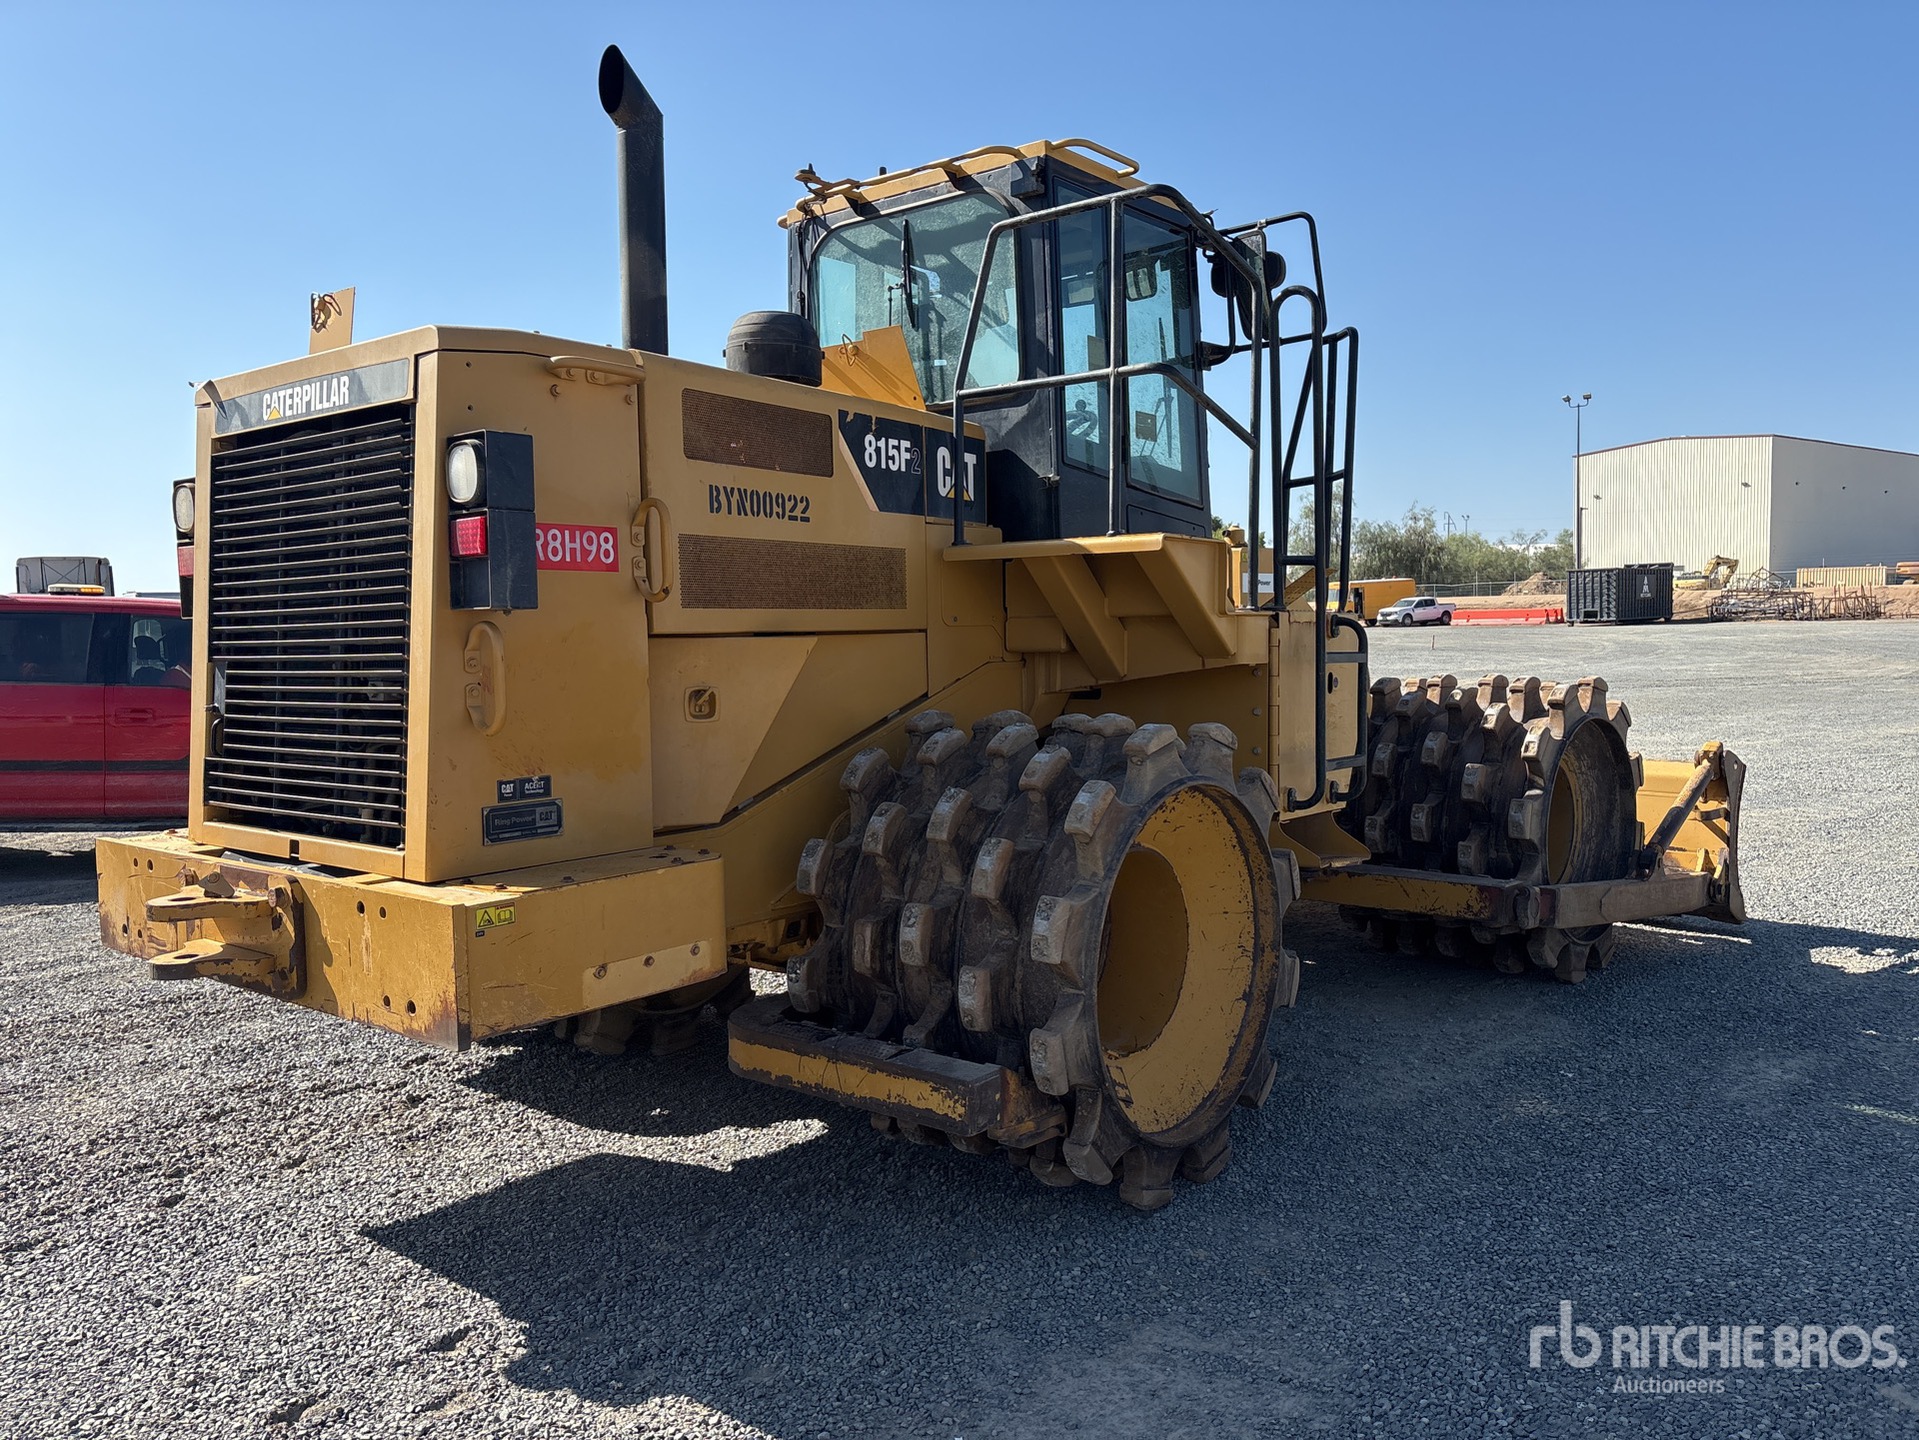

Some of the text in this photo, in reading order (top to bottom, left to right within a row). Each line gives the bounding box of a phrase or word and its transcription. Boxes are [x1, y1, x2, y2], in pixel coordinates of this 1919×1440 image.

[262, 376, 350, 421] CATERPILLAR
[937, 446, 977, 501] CT
[708, 484, 811, 523] BYN00922
[501, 784, 514, 793] CAT
[511, 815, 535, 825] Power
[539, 810, 555, 822] CAT
